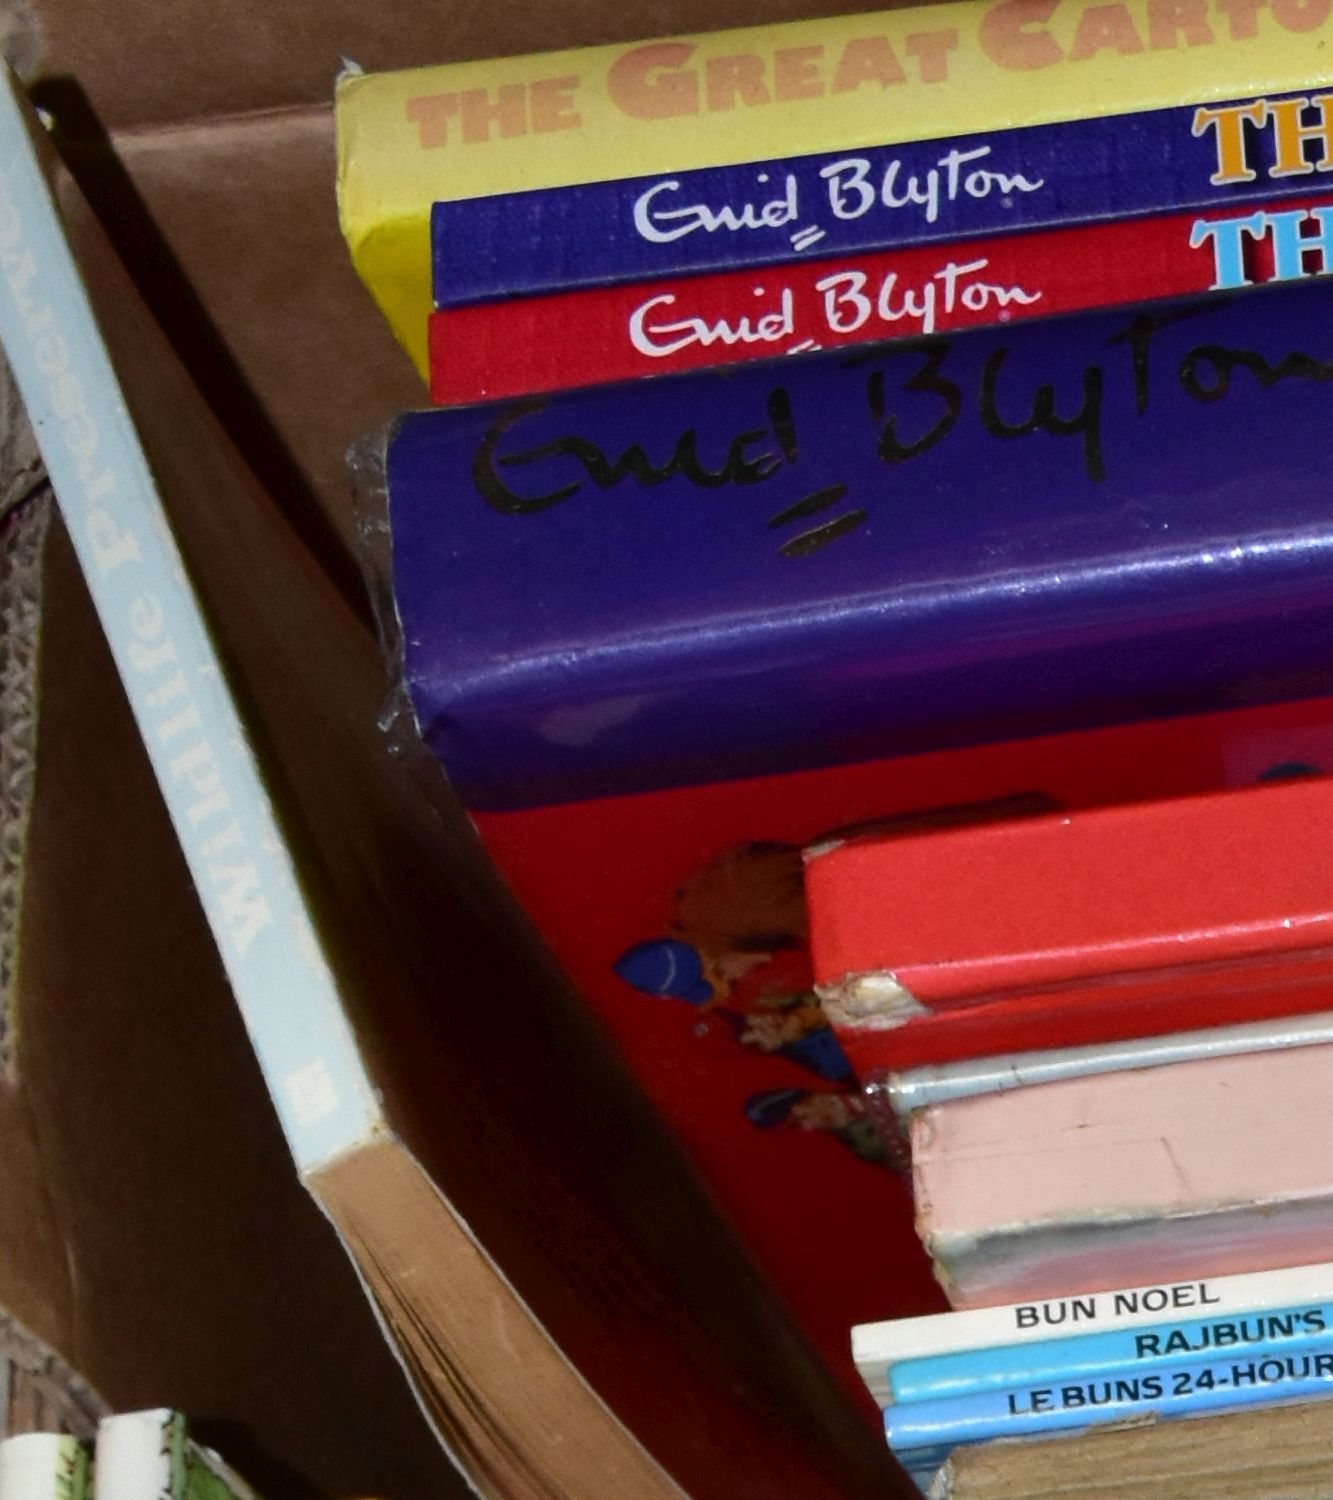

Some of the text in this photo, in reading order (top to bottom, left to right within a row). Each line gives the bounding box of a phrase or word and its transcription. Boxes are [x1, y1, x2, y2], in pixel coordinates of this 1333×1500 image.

[406, 28, 959, 150] THE GREAT
[820, 146, 1043, 224] Blyton
[816, 259, 1041, 334] Blyton
[1015, 1283, 1220, 1328] BUN NOEL
[1136, 1309, 1325, 1359] RAJBUN'S
[1008, 1388, 1054, 1416] LE
[1062, 1376, 1163, 1408] BUNS
